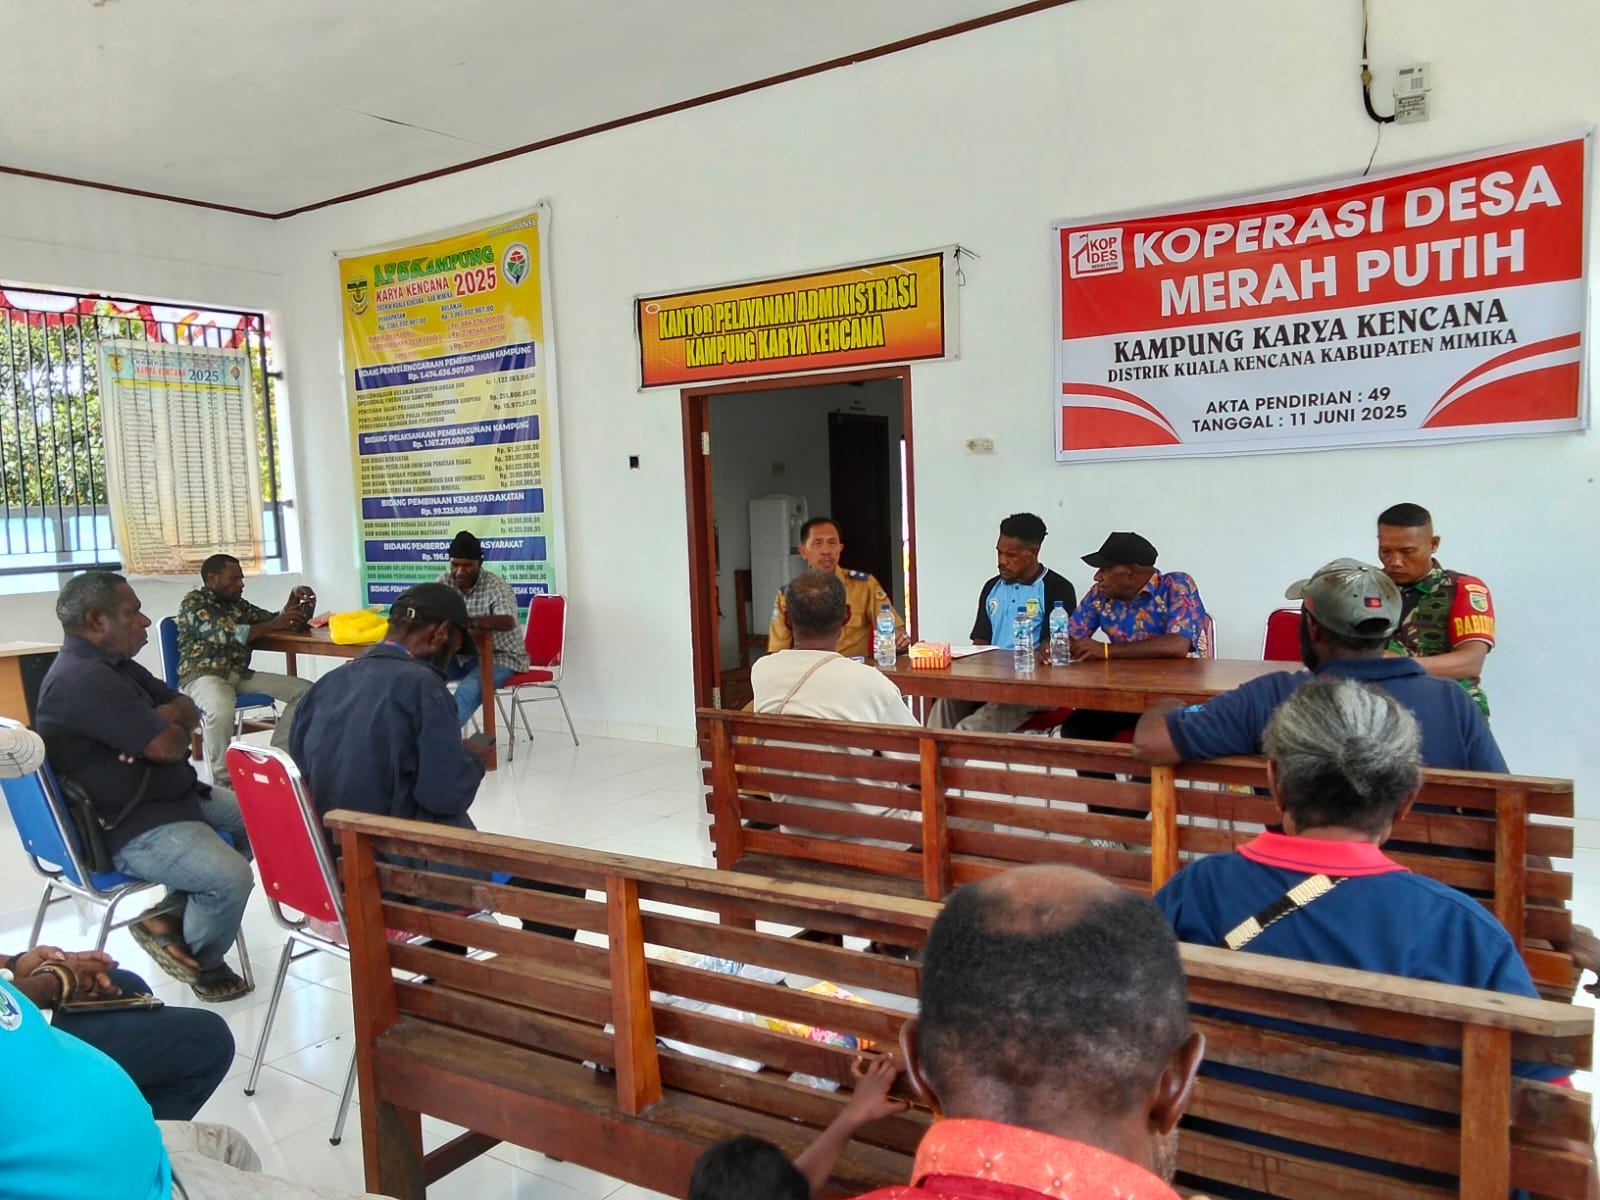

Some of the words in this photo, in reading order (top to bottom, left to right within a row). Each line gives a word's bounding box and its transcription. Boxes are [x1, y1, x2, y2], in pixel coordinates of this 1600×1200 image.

[1133, 195, 1386, 268] KOPERASI
[1404, 164, 1562, 228] DESA
[1090, 237, 1118, 251] KOP
[1091, 250, 1118, 264] DES
[376, 286, 404, 302] KARYA
[406, 277, 449, 296] KENCANA
[453, 266, 497, 297] 2025
[1160, 255, 1338, 318] MERAH
[1357, 228, 1525, 293] PUTIH
[658, 306, 714, 339] KANTOR
[715, 293, 795, 332] PELAYANAN
[797, 274, 917, 321] ADMINISTRASI
[685, 335, 756, 368] KAMPUNG
[758, 325, 808, 360] KARYA
[810, 315, 885, 353] KENCANA
[1113, 329, 1244, 364] KAMPUNG
[1252, 317, 1347, 350] KARYA
[1356, 297, 1508, 339] KENCANA
[496, 346, 532, 358] KAMPUNG
[1108, 362, 1169, 383] DISTRIK
[1173, 357, 1228, 377] KUALA
[1233, 350, 1316, 372] KENCANA
[1320, 337, 1434, 364] KABUPATEN
[1438, 328, 1518, 352] MIMIKA
[189, 368, 219, 382] 2025
[1206, 398, 1250, 414] AKTA
[1255, 389, 1352, 412] PENDIRIAN
[1367, 386, 1391, 402] 49
[389, 431, 436, 442] PELAKSANAAN
[437, 425, 491, 438] PEMBANGUNAN
[493, 420, 529, 432] KAMPUNG
[1192, 415, 1274, 433] TANGGAL
[1289, 411, 1306, 426] 11
[1310, 407, 1355, 426] JUNI
[1361, 403, 1407, 422] 2025
[381, 498, 406, 507] BIDANG
[408, 497, 452, 506] PEMBINAAN
[453, 492, 525, 504] KEMASYARAKATAN
[383, 543, 411, 551] BIDANG
[412, 542, 451, 550] PEMBERDA
[480, 541, 524, 549] ASYARAKAT
[370, 585, 389, 593] BIDANG
[529, 586, 544, 594] DESA
